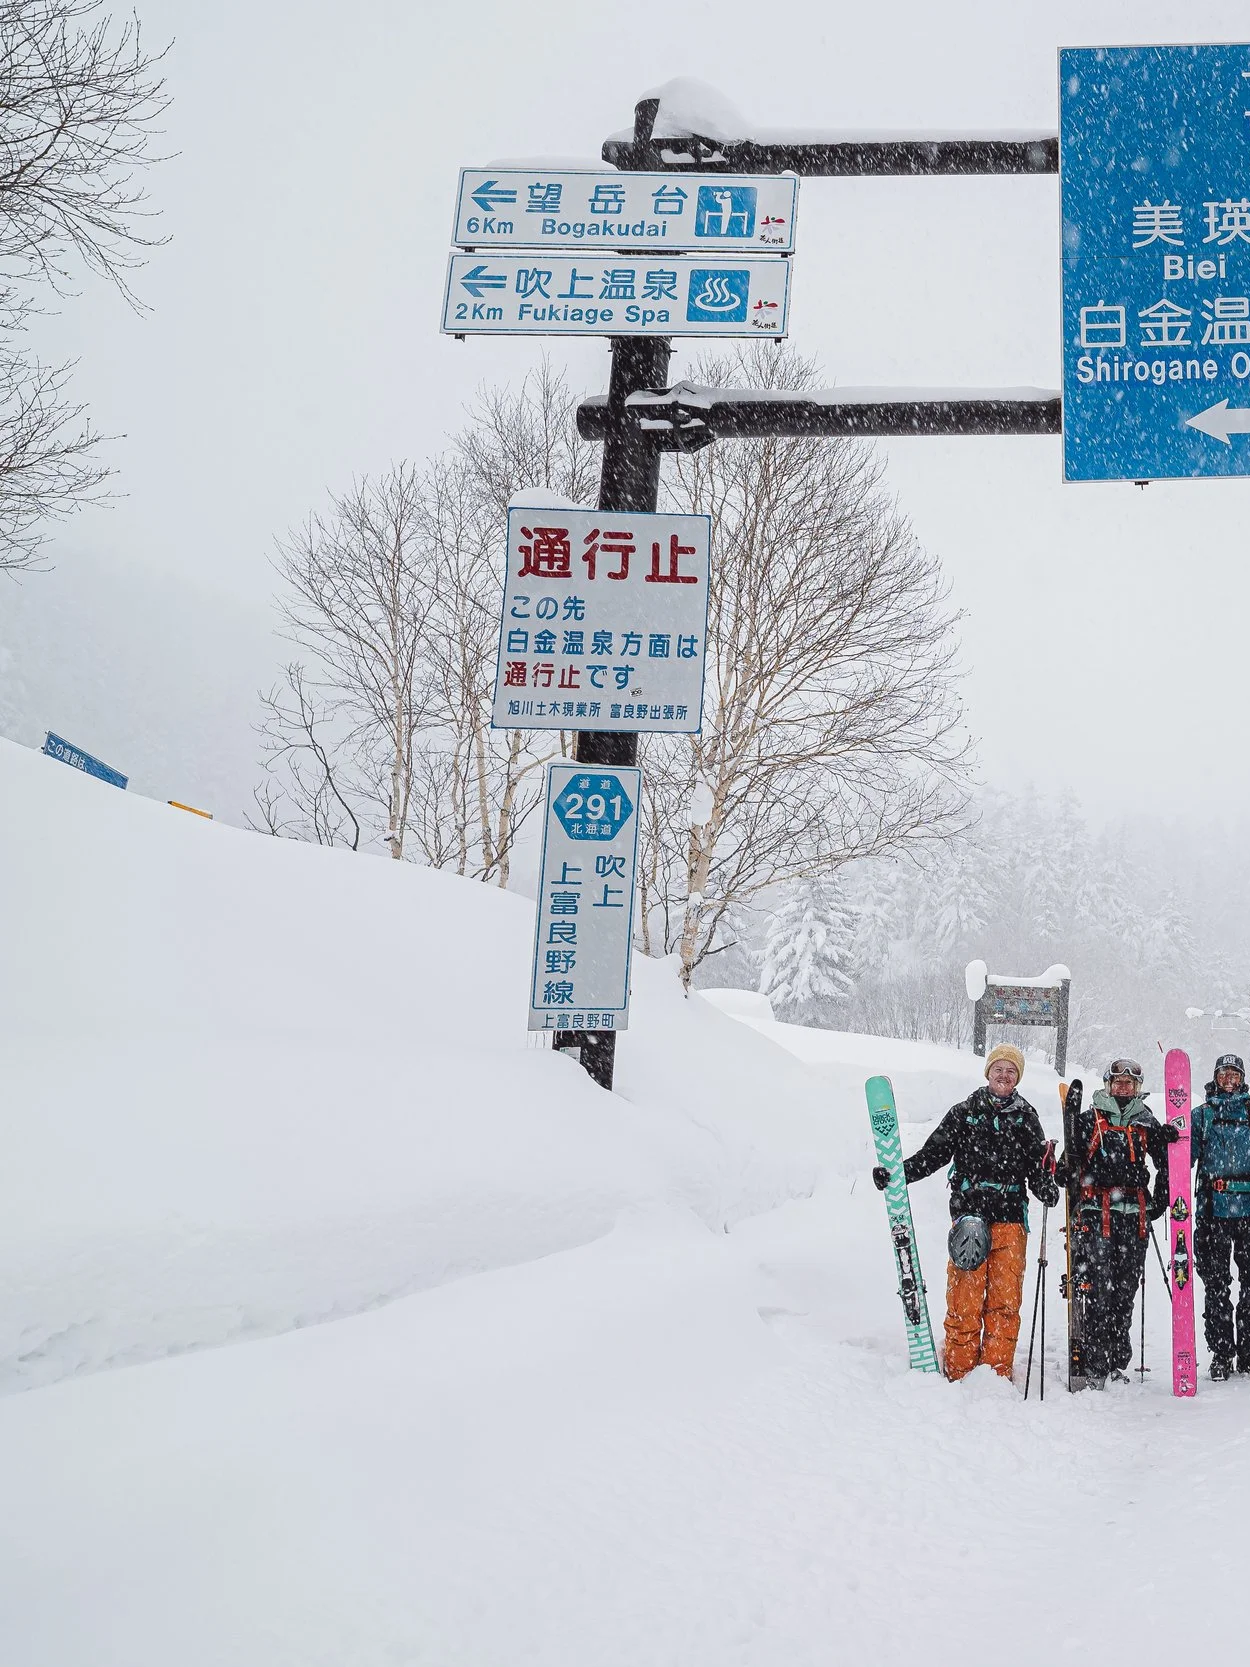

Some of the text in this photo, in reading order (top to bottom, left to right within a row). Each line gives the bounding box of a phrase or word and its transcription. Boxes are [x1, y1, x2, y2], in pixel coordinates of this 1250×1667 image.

[525, 182, 688, 215] 望岳台
[466, 217, 668, 239] 6Km Bogakudai
[1163, 256, 1226, 280] Biei
[515, 268, 678, 301] 吹上温泉
[455, 303, 670, 326] 2Km Fukiage Spa
[1077, 356, 1218, 383] Shirogane
[518, 526, 698, 584] 通行止
[511, 595, 585, 621] この先
[507, 628, 698, 658] 白金温泉方面は
[504, 661, 635, 690] 通行止です
[508, 700, 688, 721] 旭川土木現業所 富良野出張所
[564, 794, 623, 821] 291
[570, 823, 612, 836] 北海道
[592, 855, 626, 908] 吹上
[543, 861, 582, 1005] 上富良野線
[541, 1013, 615, 1029] 上富良野町
